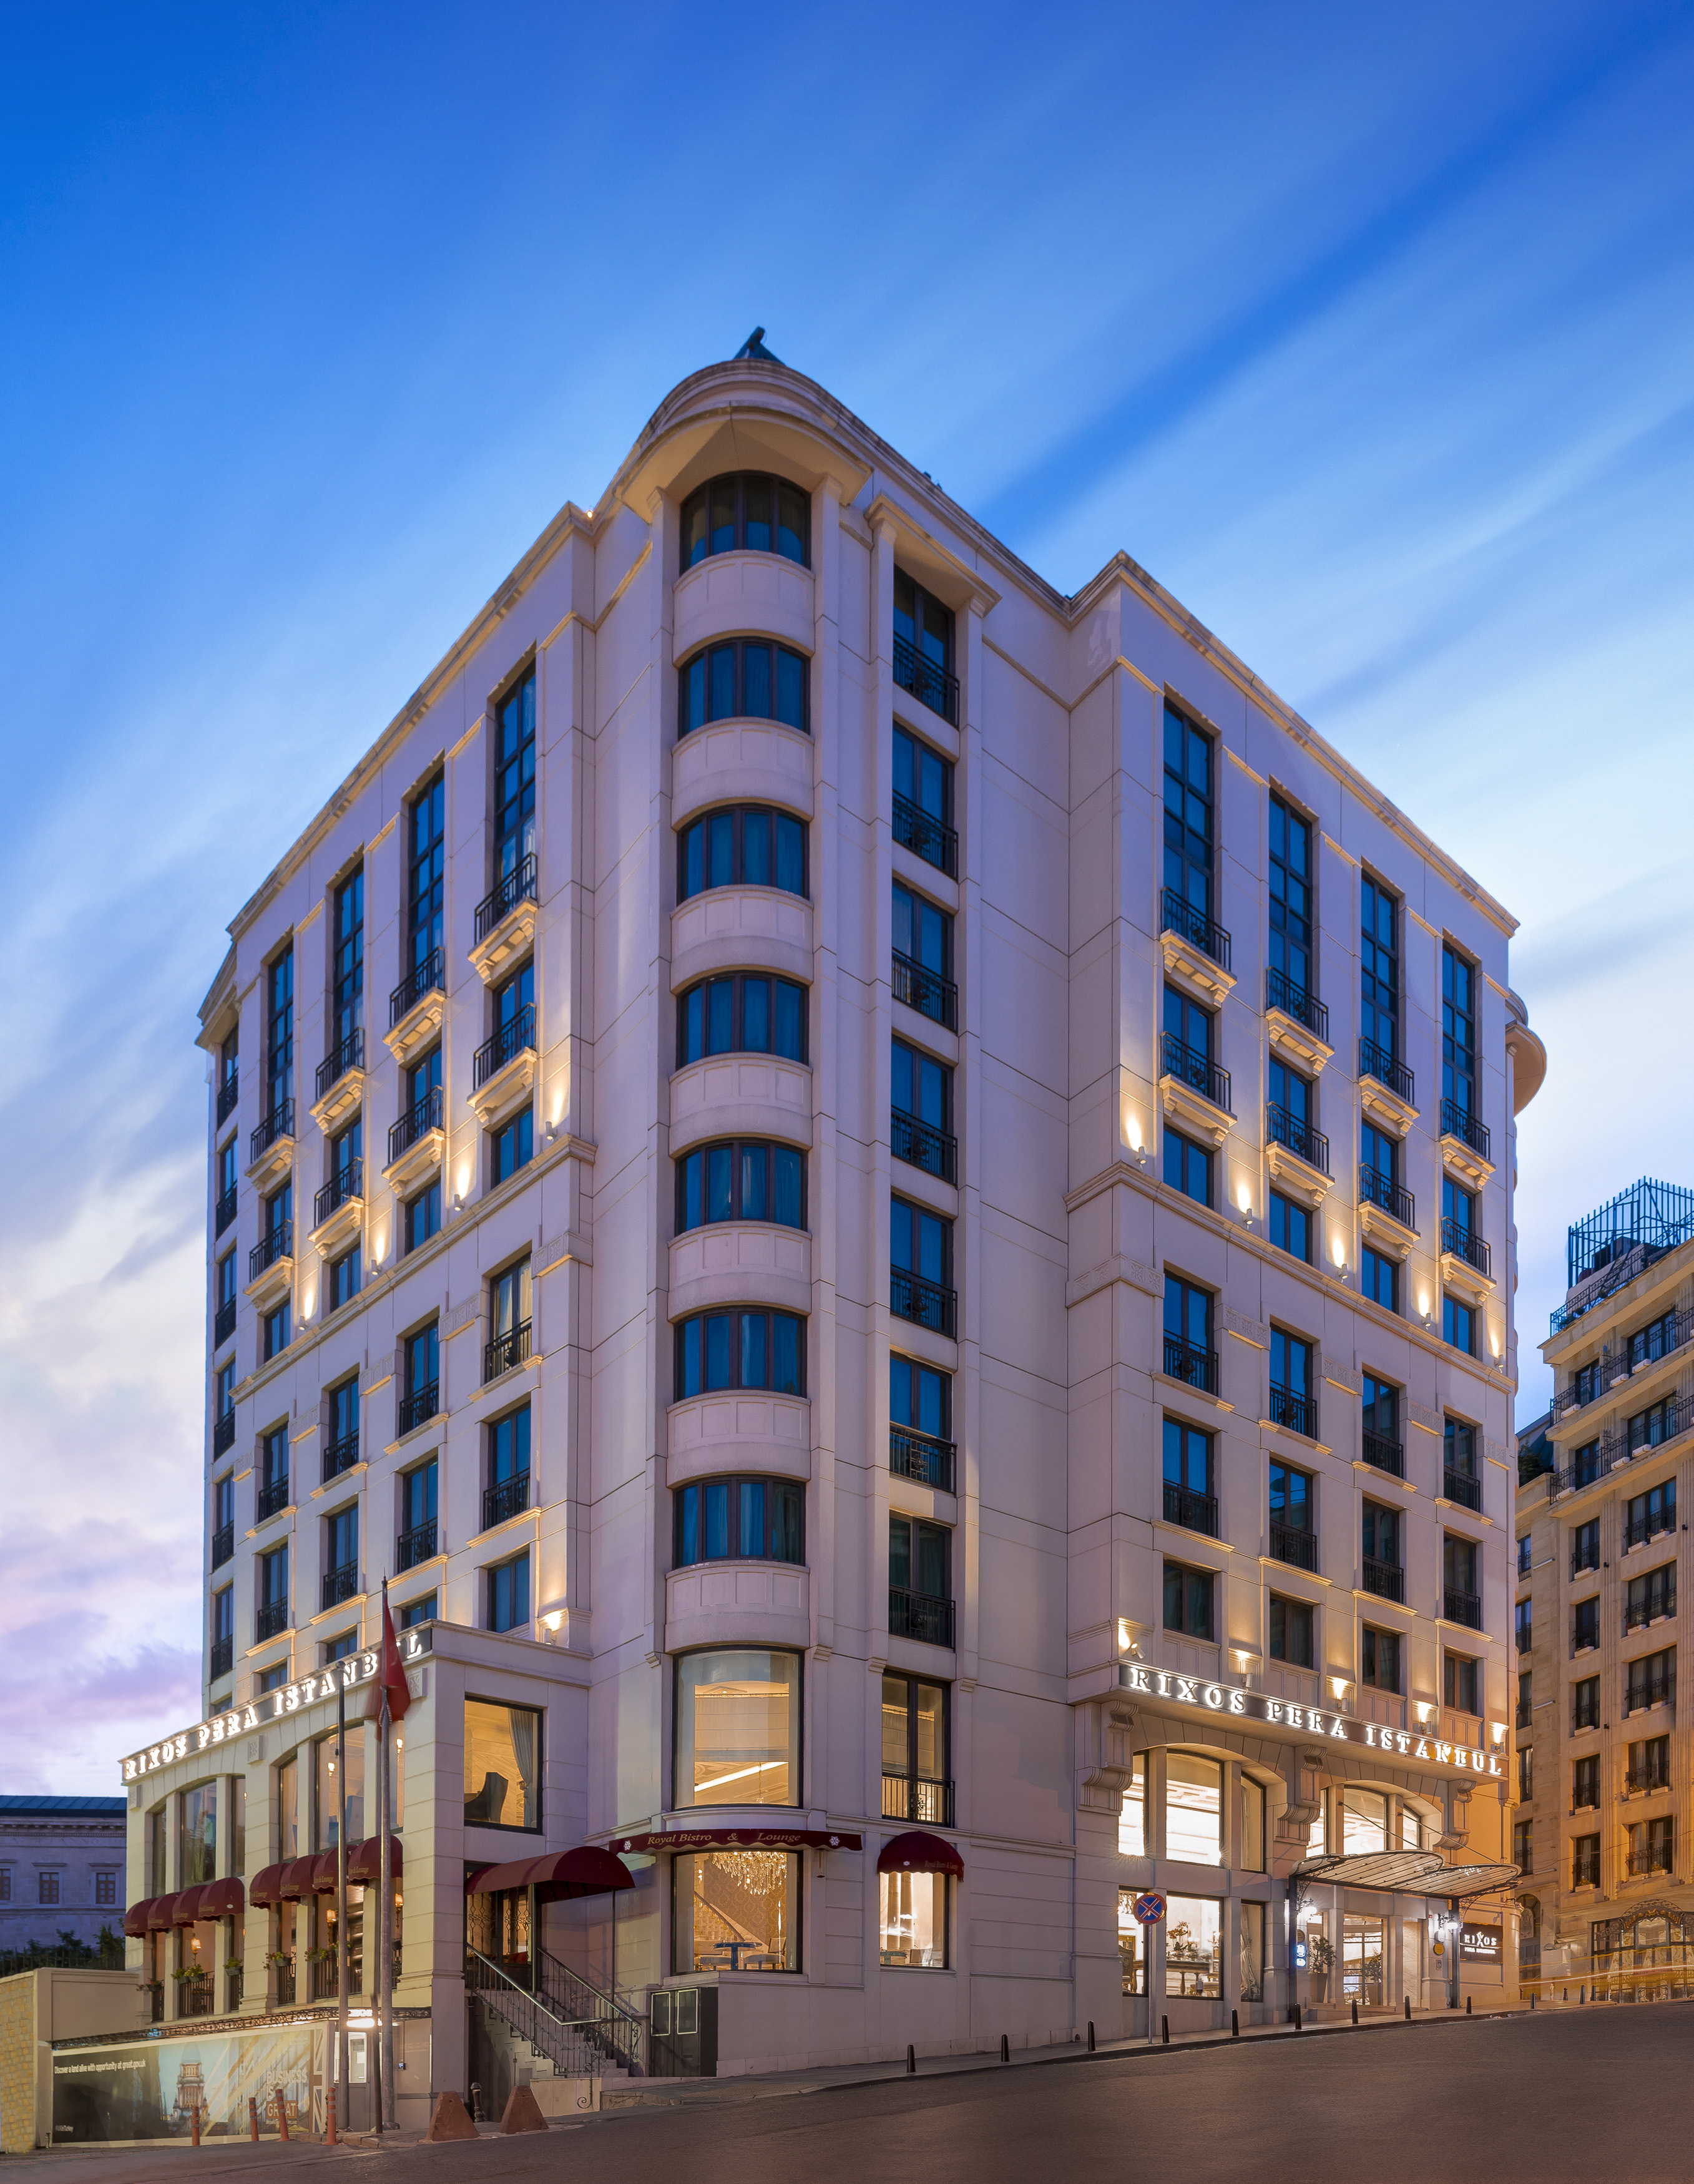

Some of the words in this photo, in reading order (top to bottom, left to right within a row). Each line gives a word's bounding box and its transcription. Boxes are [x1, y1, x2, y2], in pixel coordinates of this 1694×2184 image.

[125, 1734, 187, 1779] RIXOS
[198, 1706, 258, 1748] PERA
[274, 1634, 422, 1716] ISTANBL
[1130, 1667, 1245, 1714] RIXOS
[1267, 1701, 1348, 1738] PERA
[1366, 1727, 1501, 1775] ISTANBUL
[647, 1834, 676, 1845] Royal
[678, 1833, 712, 1842] Bistro
[727, 1833, 739, 1841] &
[757, 1833, 801, 1843] Lounge
[1464, 1931, 1497, 1948] RIXOS
[54, 2066, 69, 2074] Discover
[71, 2064, 79, 2073] land
[87, 2063, 95, 2072] with
[95, 2061, 117, 2072] opportunity
[117, 2060, 122, 2069] at
[267, 2069, 308, 2085] BUSINESS
[266, 2085, 275, 2100] IS
[267, 2103, 296, 2117] GRAT
